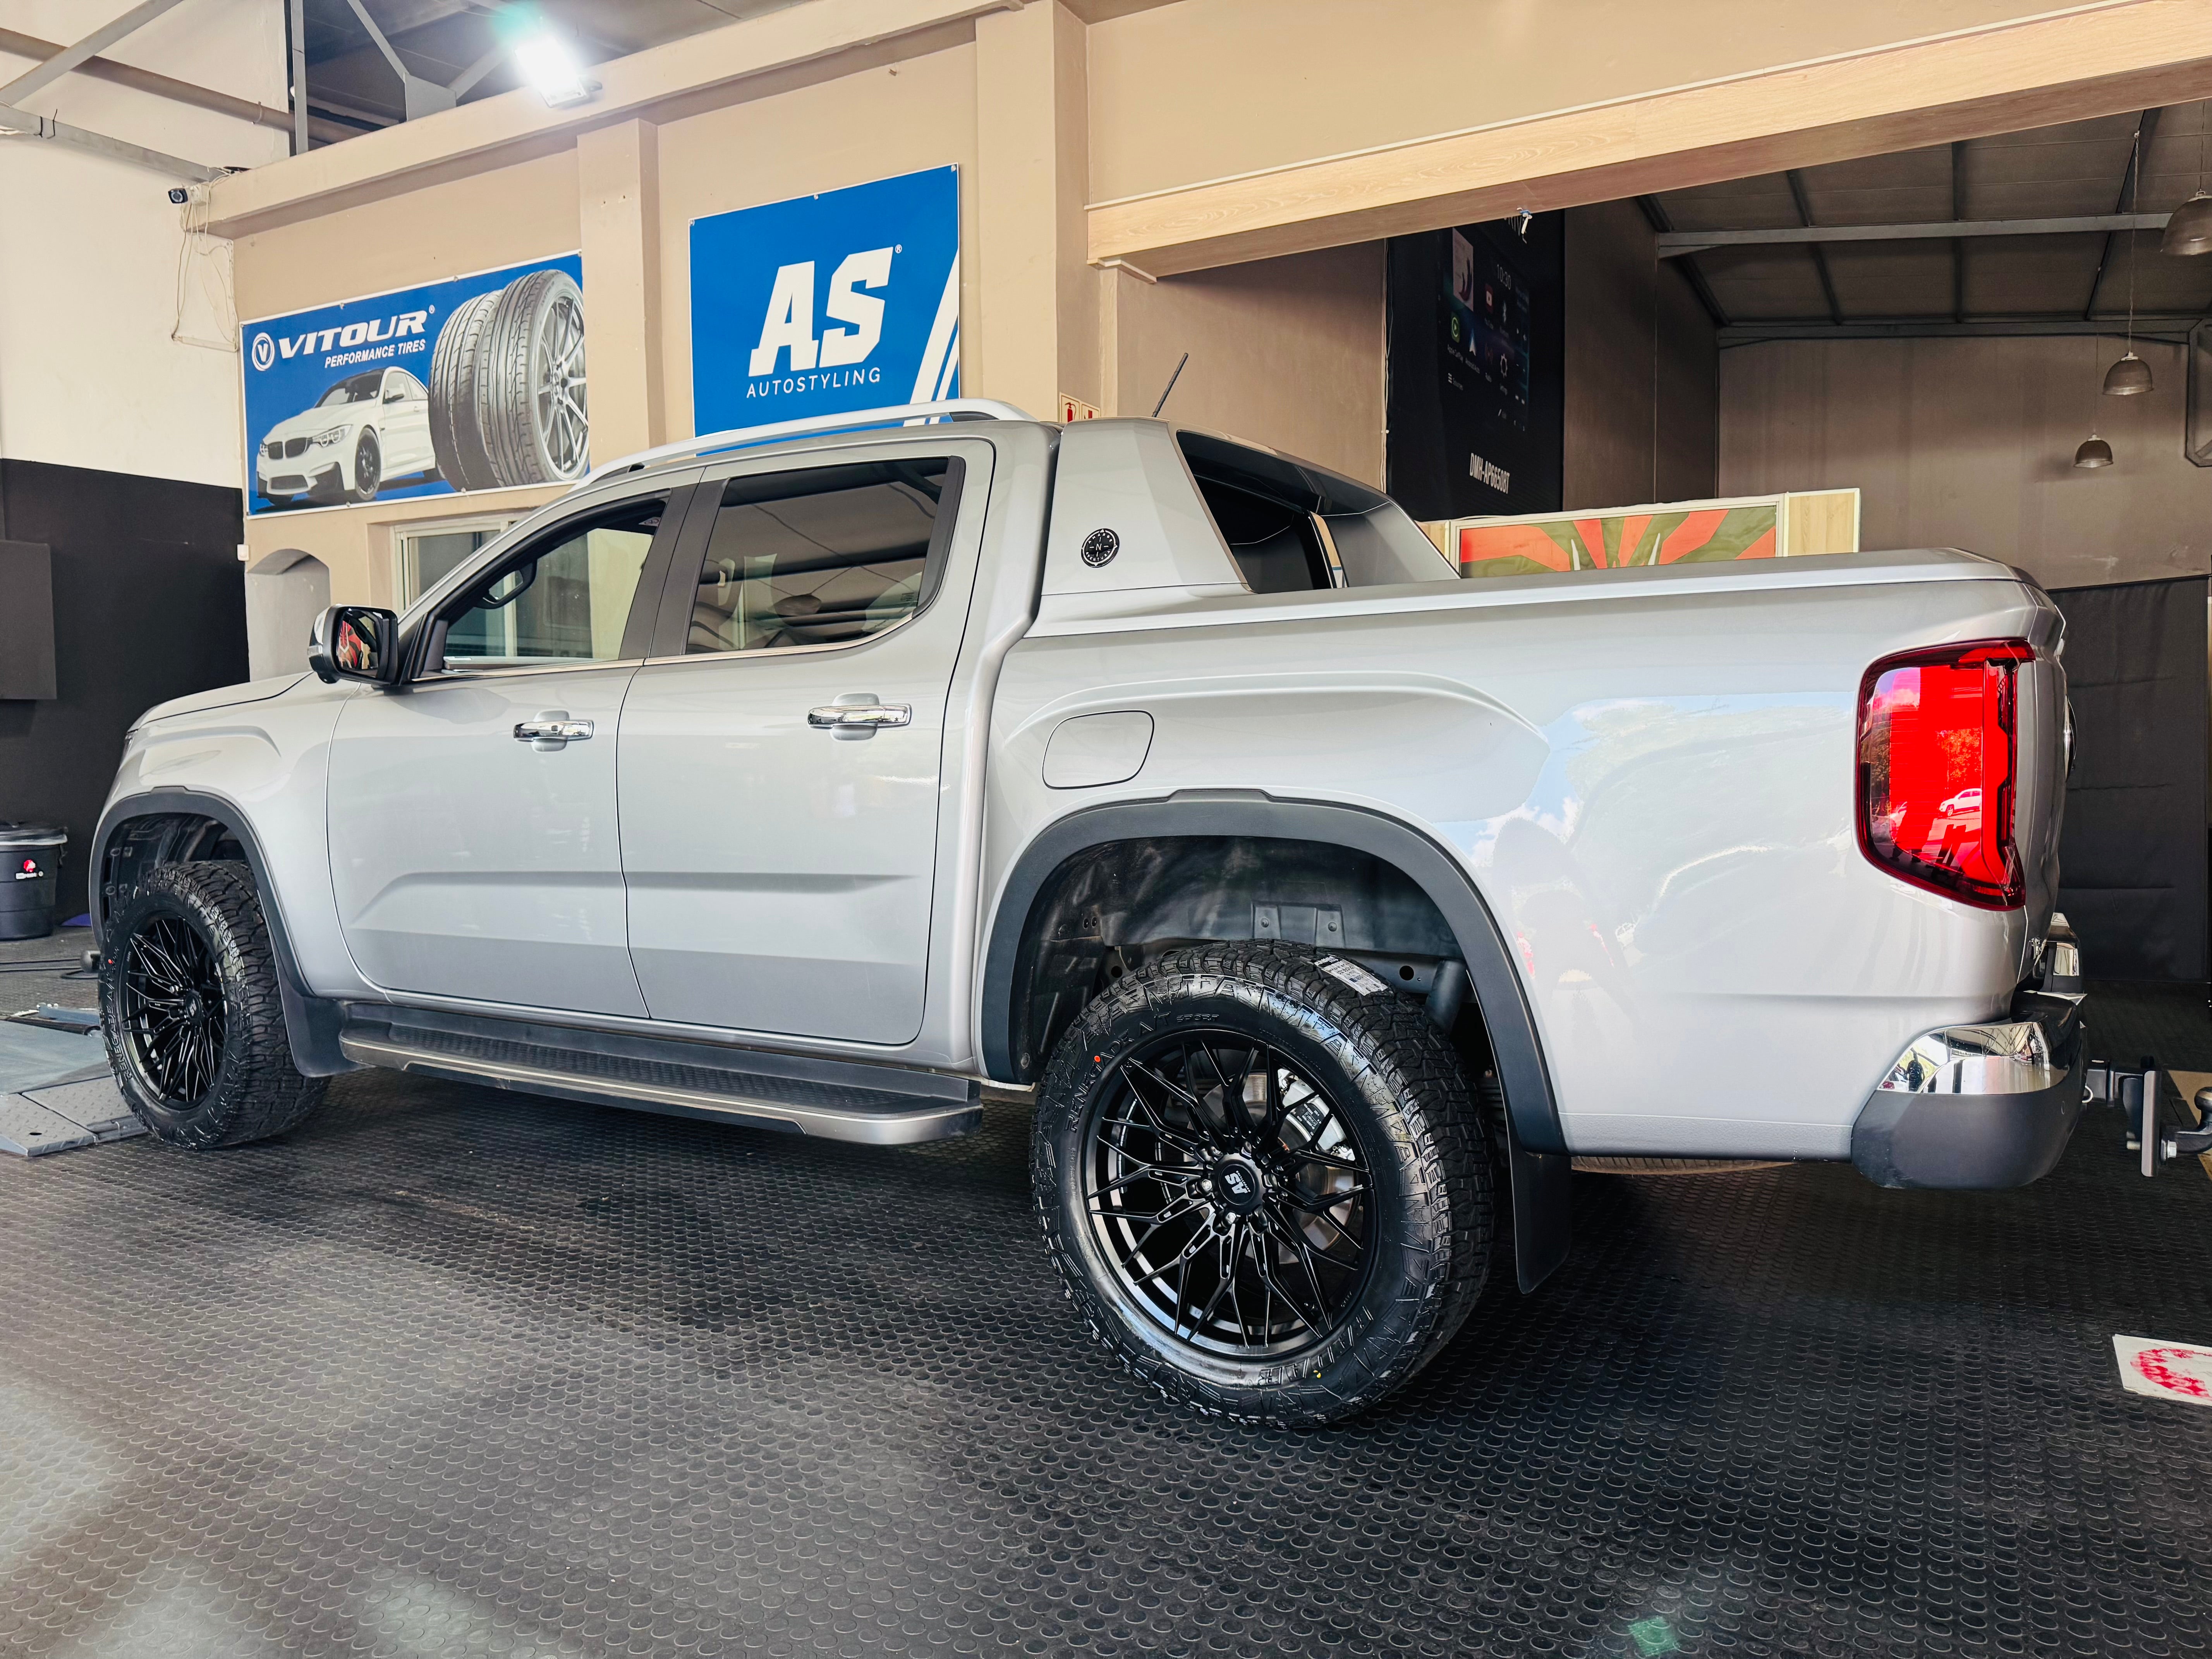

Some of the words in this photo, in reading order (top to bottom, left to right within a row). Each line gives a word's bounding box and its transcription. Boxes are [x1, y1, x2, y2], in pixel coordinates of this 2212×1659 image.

[748, 246, 893, 377] AS
[278, 310, 428, 359] VITOUR
[324, 346, 395, 368] PERFORMANCE
[397, 338, 426, 354] TIRES
[746, 367, 880, 398] AUTOSTYLING
[1470, 452, 1510, 494] DMH-AP6650BT
[1086, 550, 1110, 562] AVENTURA
[1064, 1029, 1135, 1133] RENEGADE
[1176, 1013, 1219, 1022] SPORT
[1224, 1173, 1248, 1194] AS
